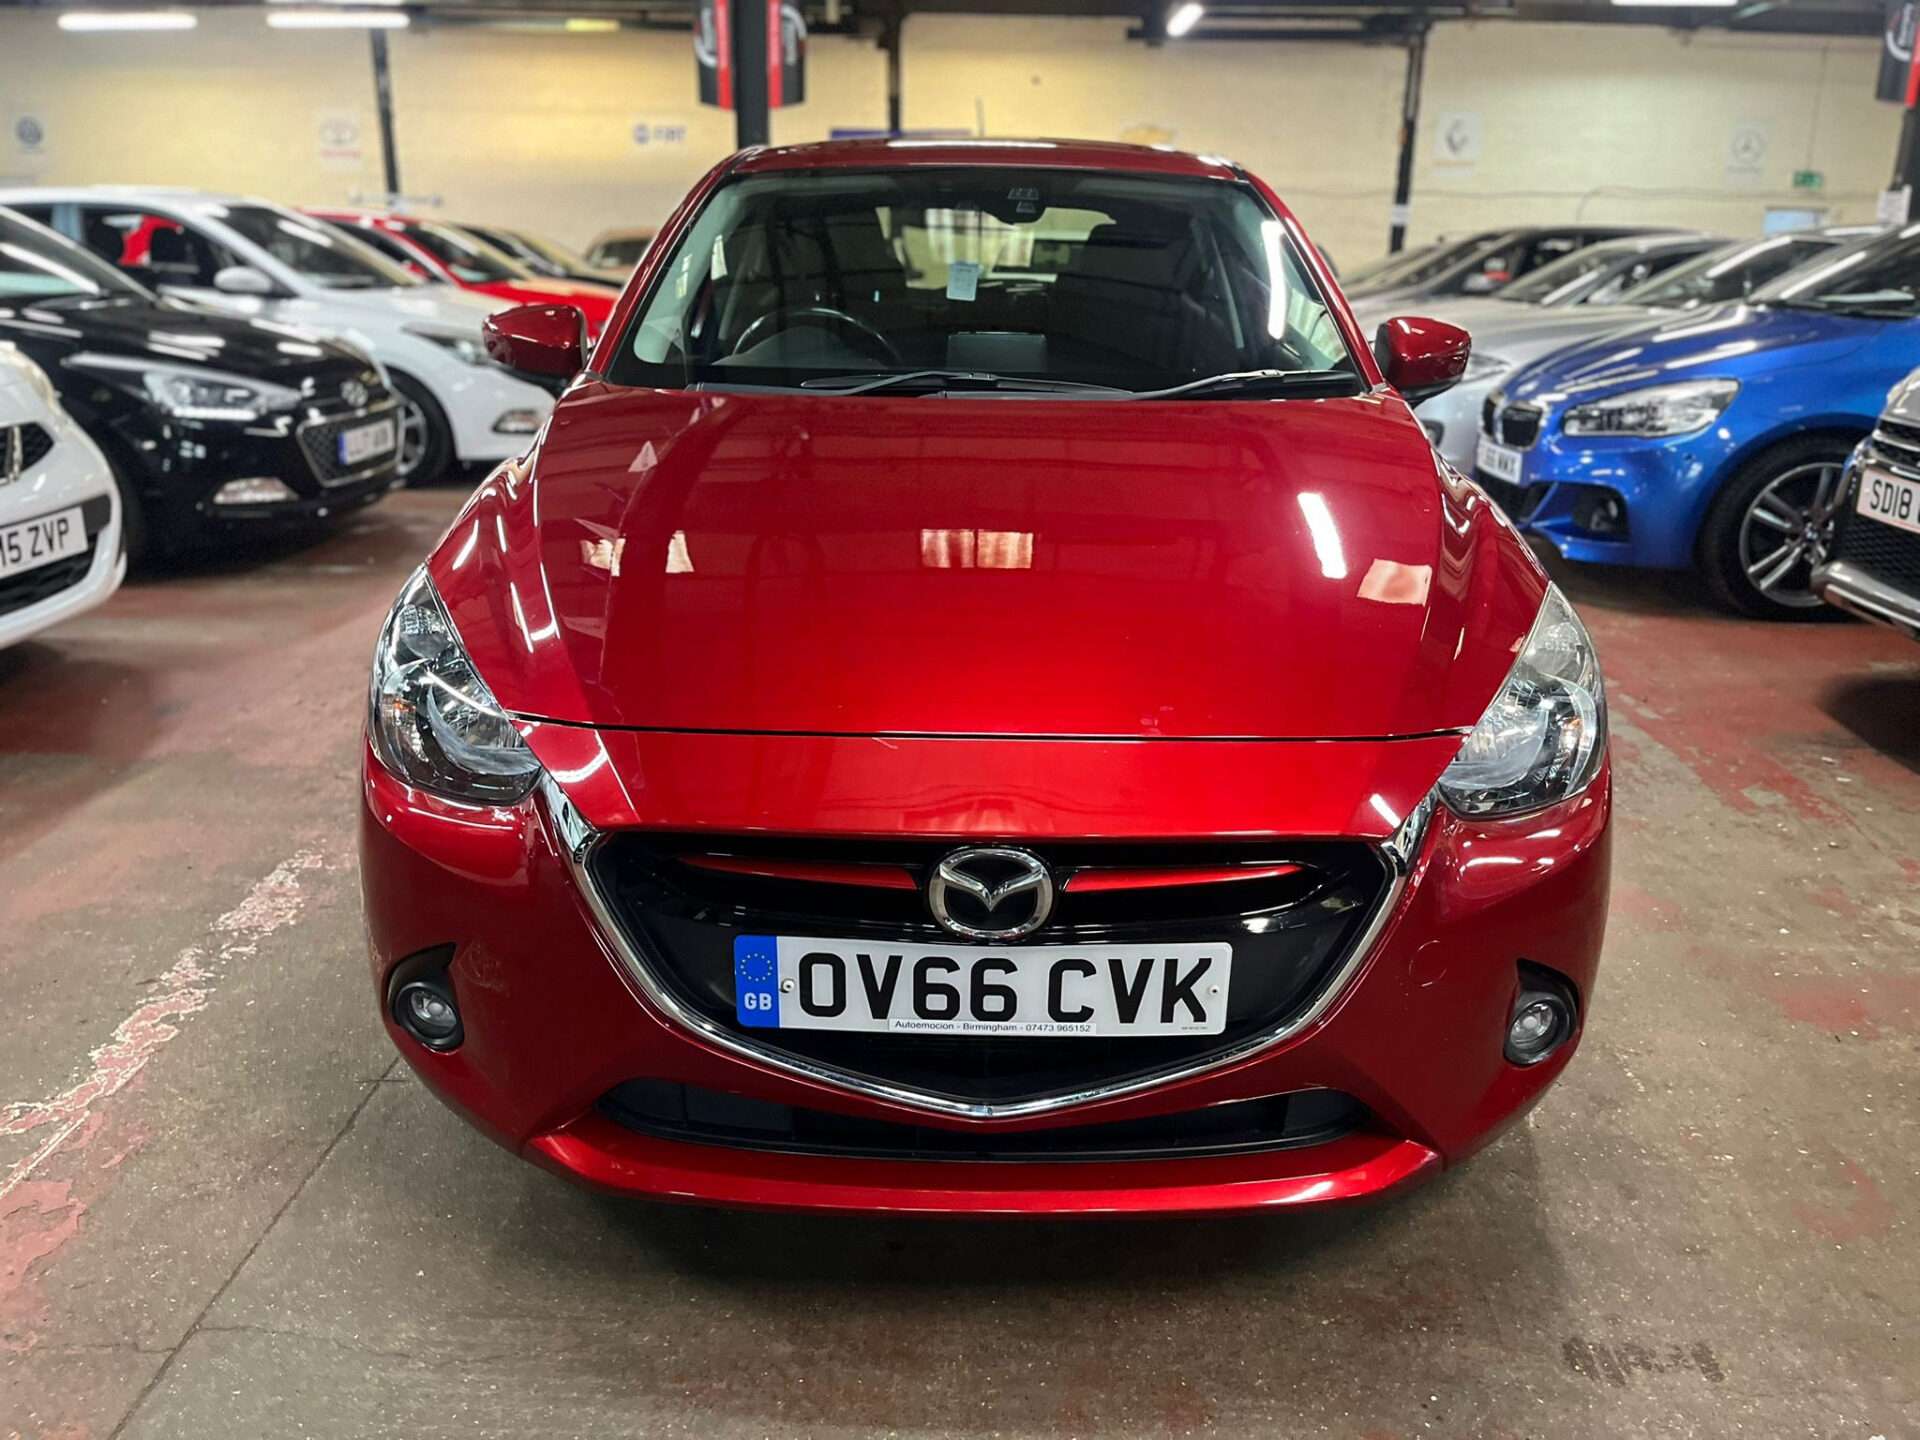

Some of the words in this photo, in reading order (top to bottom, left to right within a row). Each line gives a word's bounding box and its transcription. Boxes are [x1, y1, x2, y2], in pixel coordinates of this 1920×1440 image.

[27, 518, 69, 557] ZVP
[744, 992, 772, 1011] GB
[799, 952, 1018, 1022] OV66
[1047, 957, 1212, 1024] CVK
[895, 1020, 954, 1030] Autoemocion
[962, 1022, 1017, 1032] Birmingham
[1025, 1023, 1055, 1032] 07473
[1056, 1023, 1091, 1033] 965152
